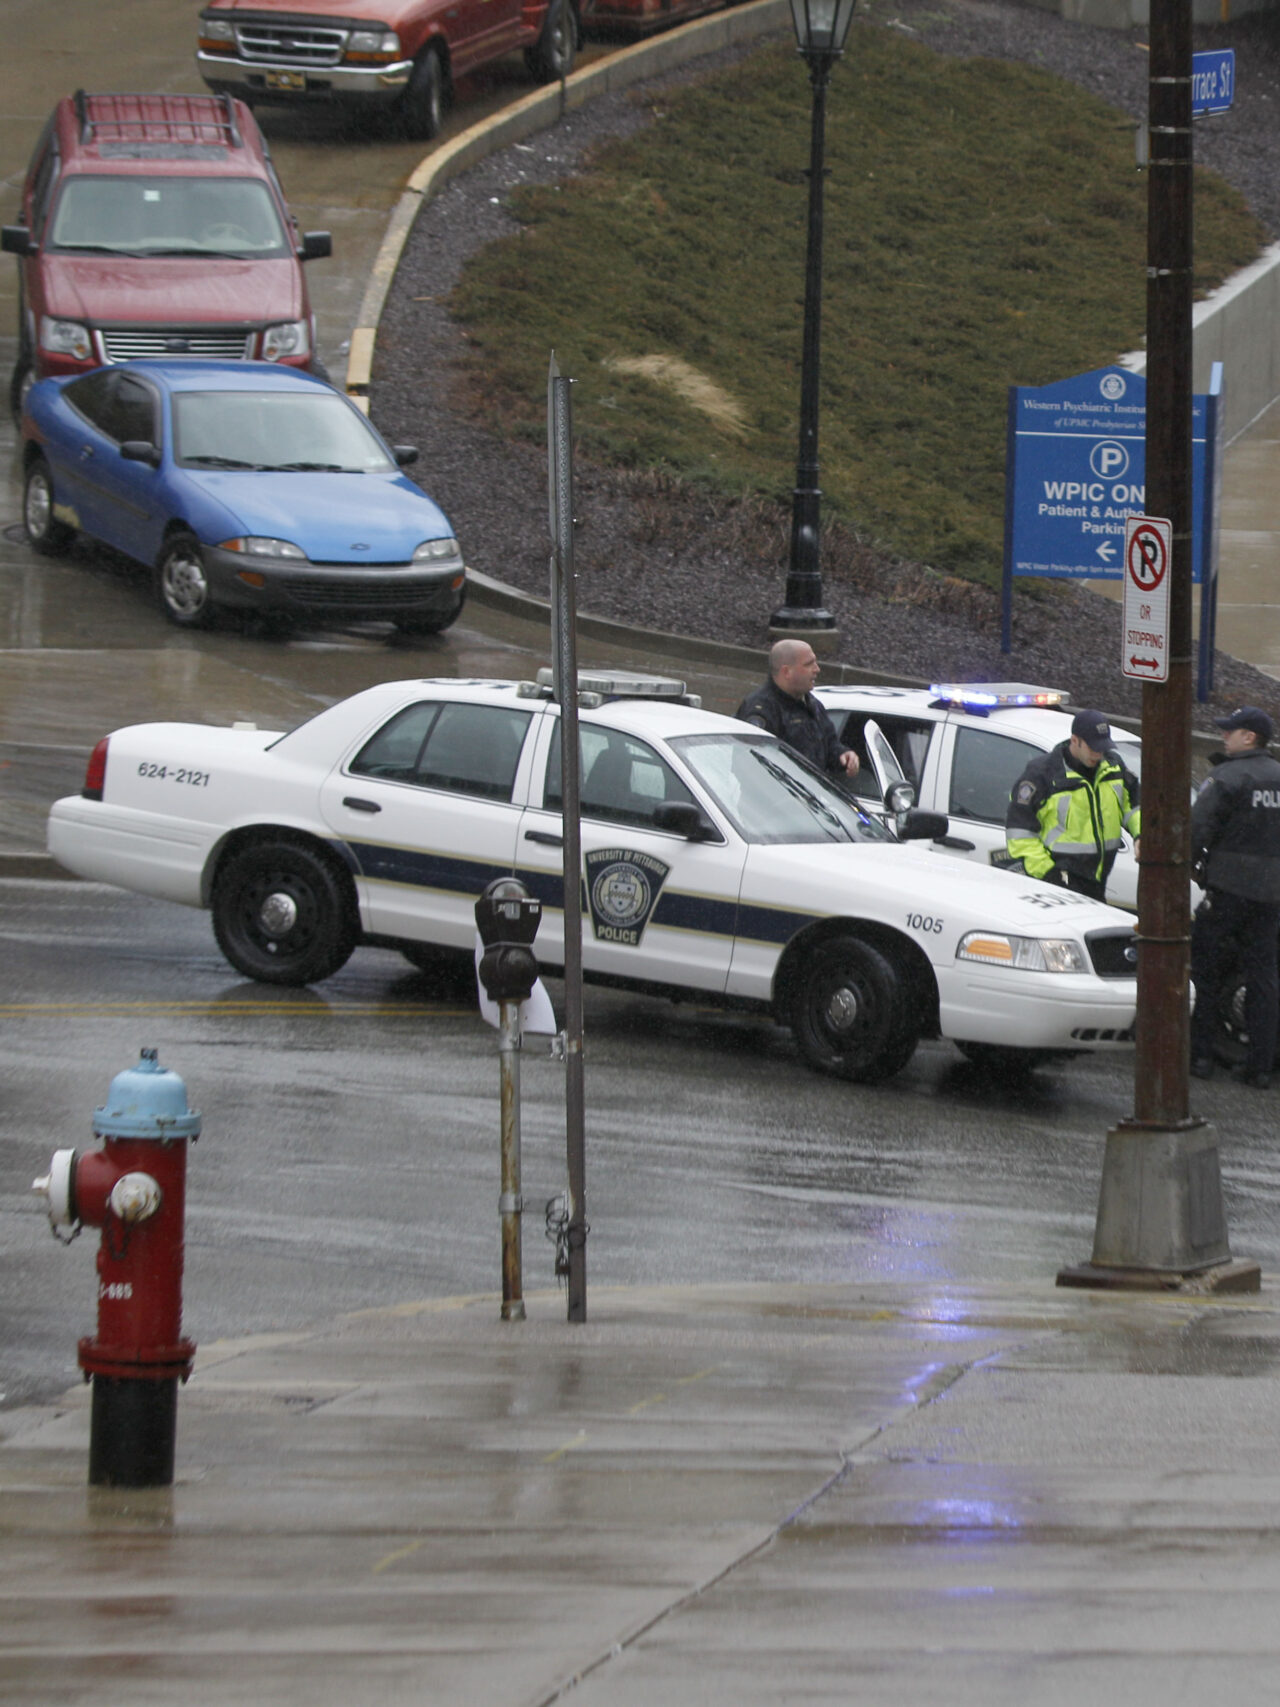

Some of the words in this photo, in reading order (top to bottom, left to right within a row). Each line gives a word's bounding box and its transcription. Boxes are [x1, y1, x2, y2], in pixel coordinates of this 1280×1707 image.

[1192, 70, 1217, 101] rrace
[1219, 61, 1231, 98] St
[1023, 399, 1061, 411] Western
[1063, 401, 1112, 414] Psychiatric
[1114, 402, 1146, 414] Institut
[1100, 447, 1123, 474] P
[1043, 481, 1105, 502] WPIC
[1111, 484, 1145, 504] ON
[1038, 503, 1088, 517] Patient
[1090, 505, 1101, 518] &
[1104, 506, 1145, 518] Autho
[1081, 521, 1126, 535] Parkin
[1139, 604, 1152, 621] OR
[1127, 630, 1164, 649] STOPPING
[137, 762, 210, 787] 624-2121
[587, 849, 623, 864] UNIVERSITY
[623, 850, 633, 861] OF
[906, 912, 944, 934] 1005
[598, 925, 638, 944] POLICE
